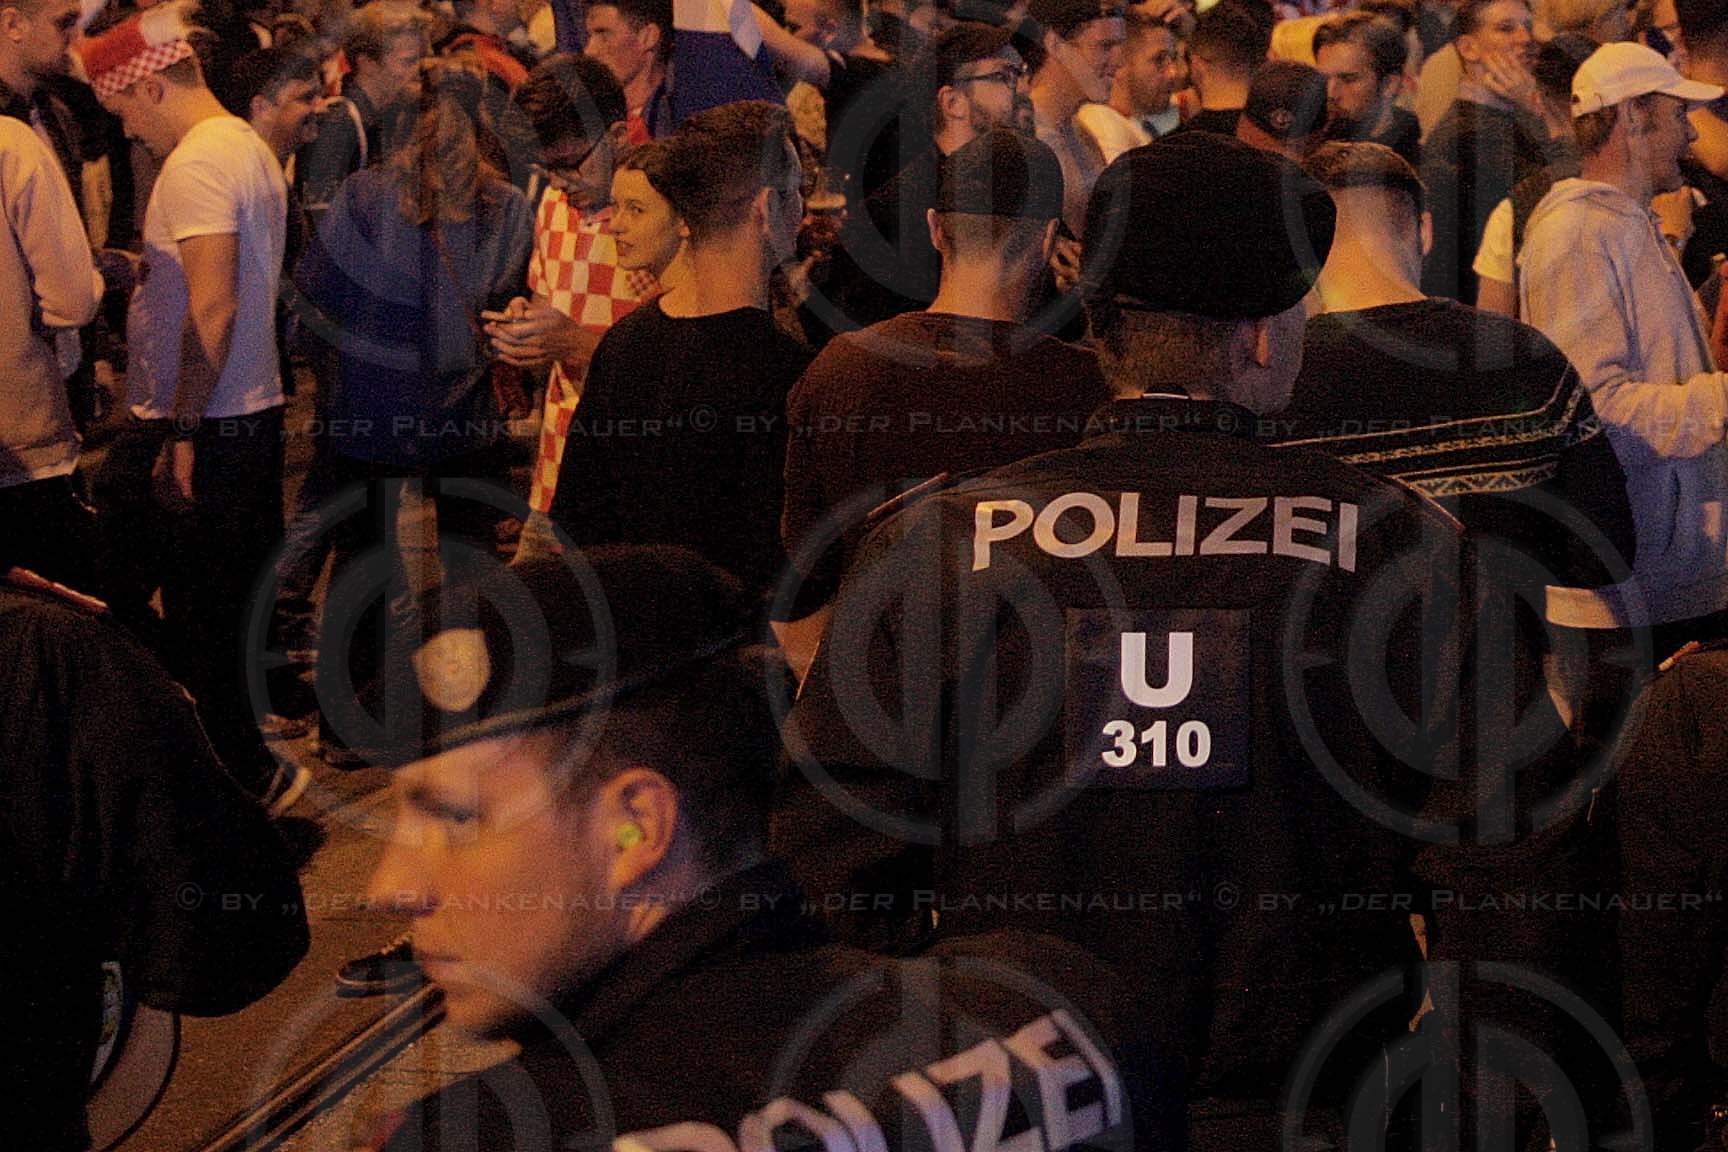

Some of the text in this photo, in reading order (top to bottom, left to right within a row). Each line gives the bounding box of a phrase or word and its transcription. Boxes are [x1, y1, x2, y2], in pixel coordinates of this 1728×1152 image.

[972, 492, 1359, 573] POLIZEI
[1120, 631, 1194, 708] U
[1102, 719, 1212, 769] 310
